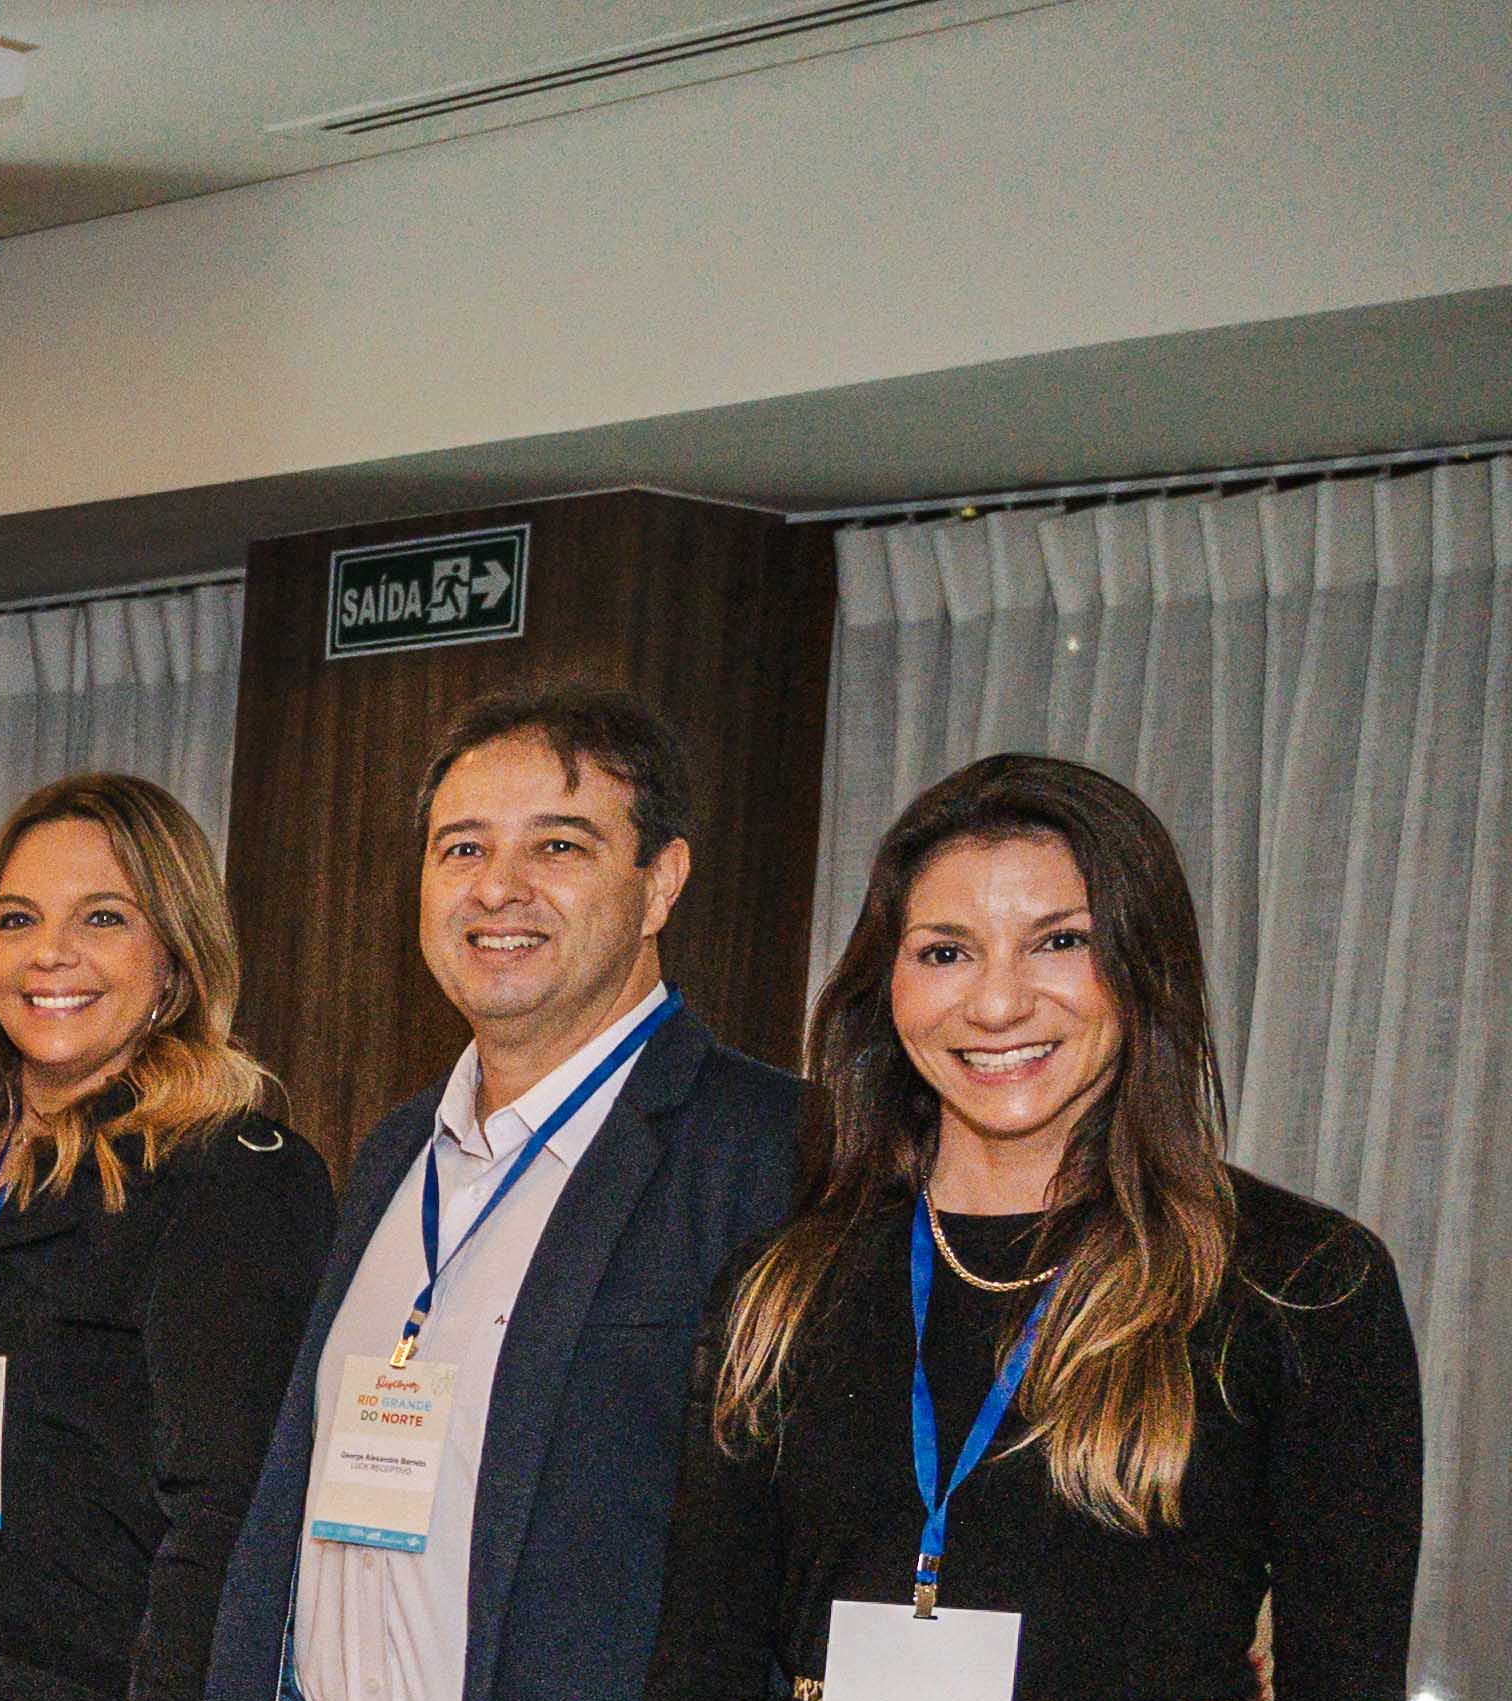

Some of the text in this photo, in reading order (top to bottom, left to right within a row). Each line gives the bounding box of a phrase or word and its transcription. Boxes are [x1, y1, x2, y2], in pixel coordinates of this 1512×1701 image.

[341, 573, 423, 628] SAÍDA
[357, 1394, 432, 1412] RIO GRANDE
[360, 1410, 424, 1427] DO NORTE
